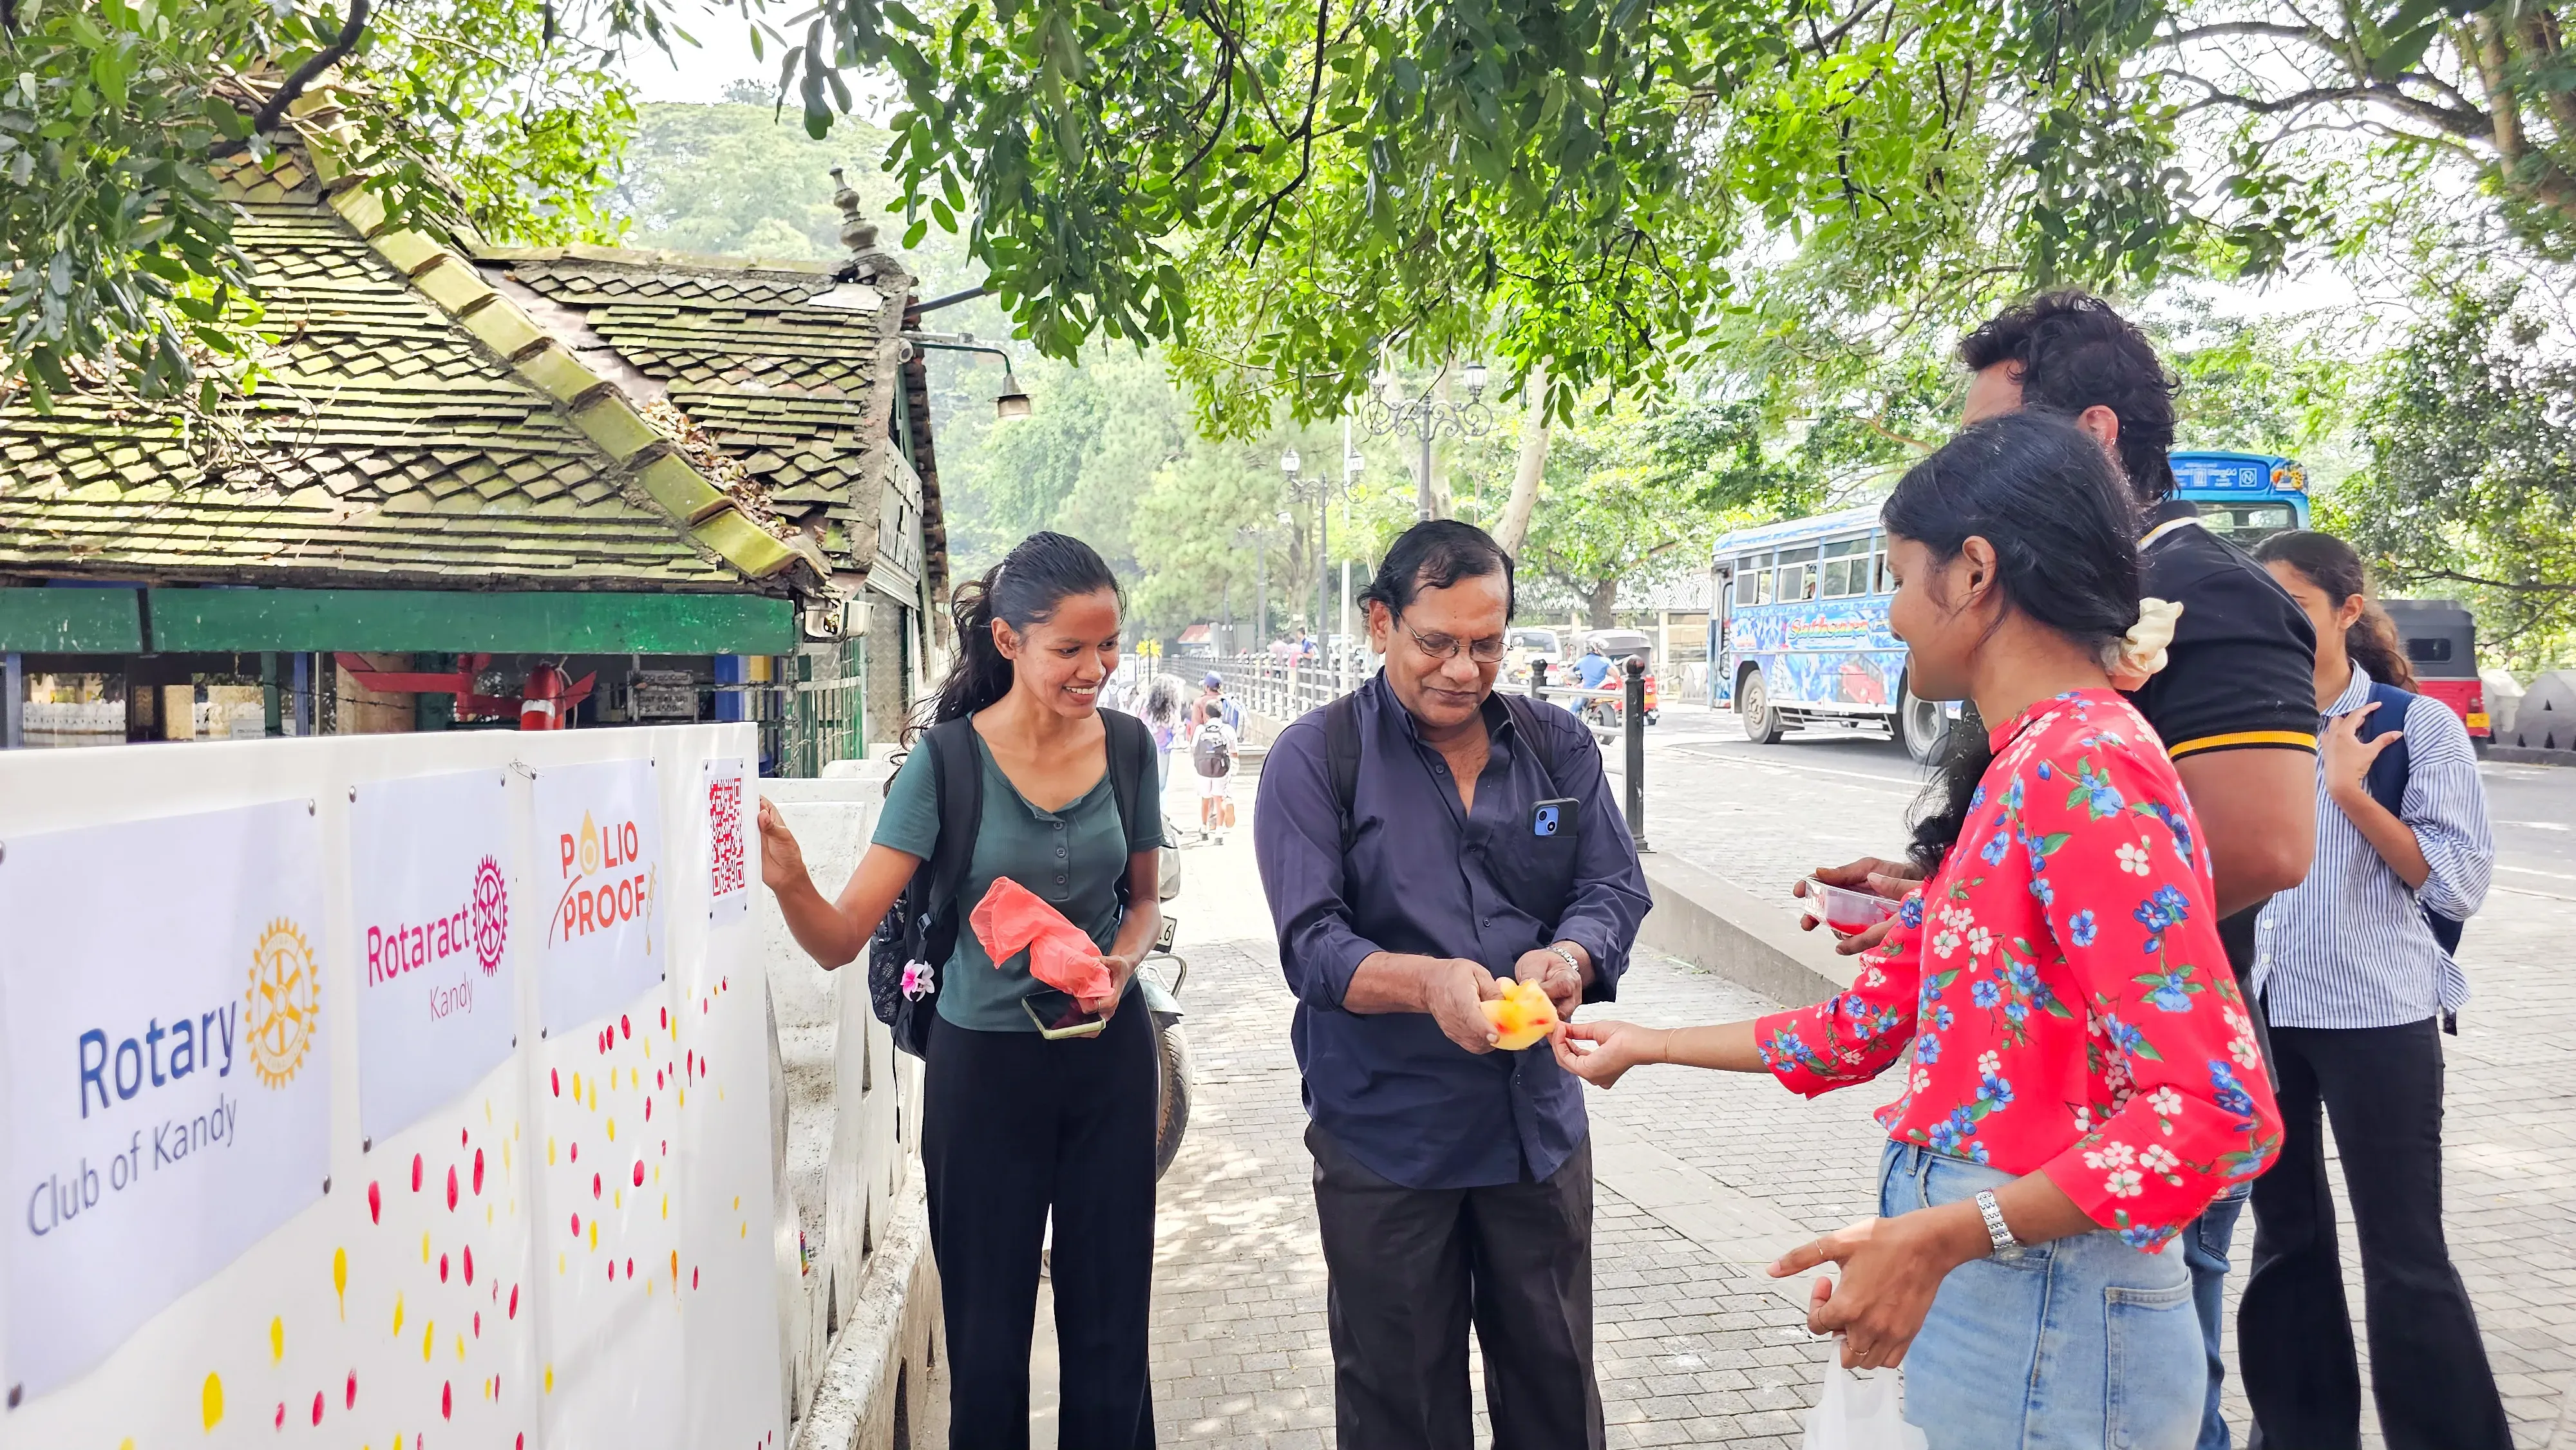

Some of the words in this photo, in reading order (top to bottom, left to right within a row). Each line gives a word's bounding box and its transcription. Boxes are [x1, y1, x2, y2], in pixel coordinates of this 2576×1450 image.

[560, 809, 638, 880] POLIO
[367, 903, 469, 988] Rotaract
[564, 874, 645, 942] PROOF
[430, 971, 473, 1022] Kandy
[79, 1000, 237, 1120] Rotary
[27, 1157, 100, 1236] Club
[111, 1130, 142, 1191] of
[154, 1092, 237, 1171] Kandy
